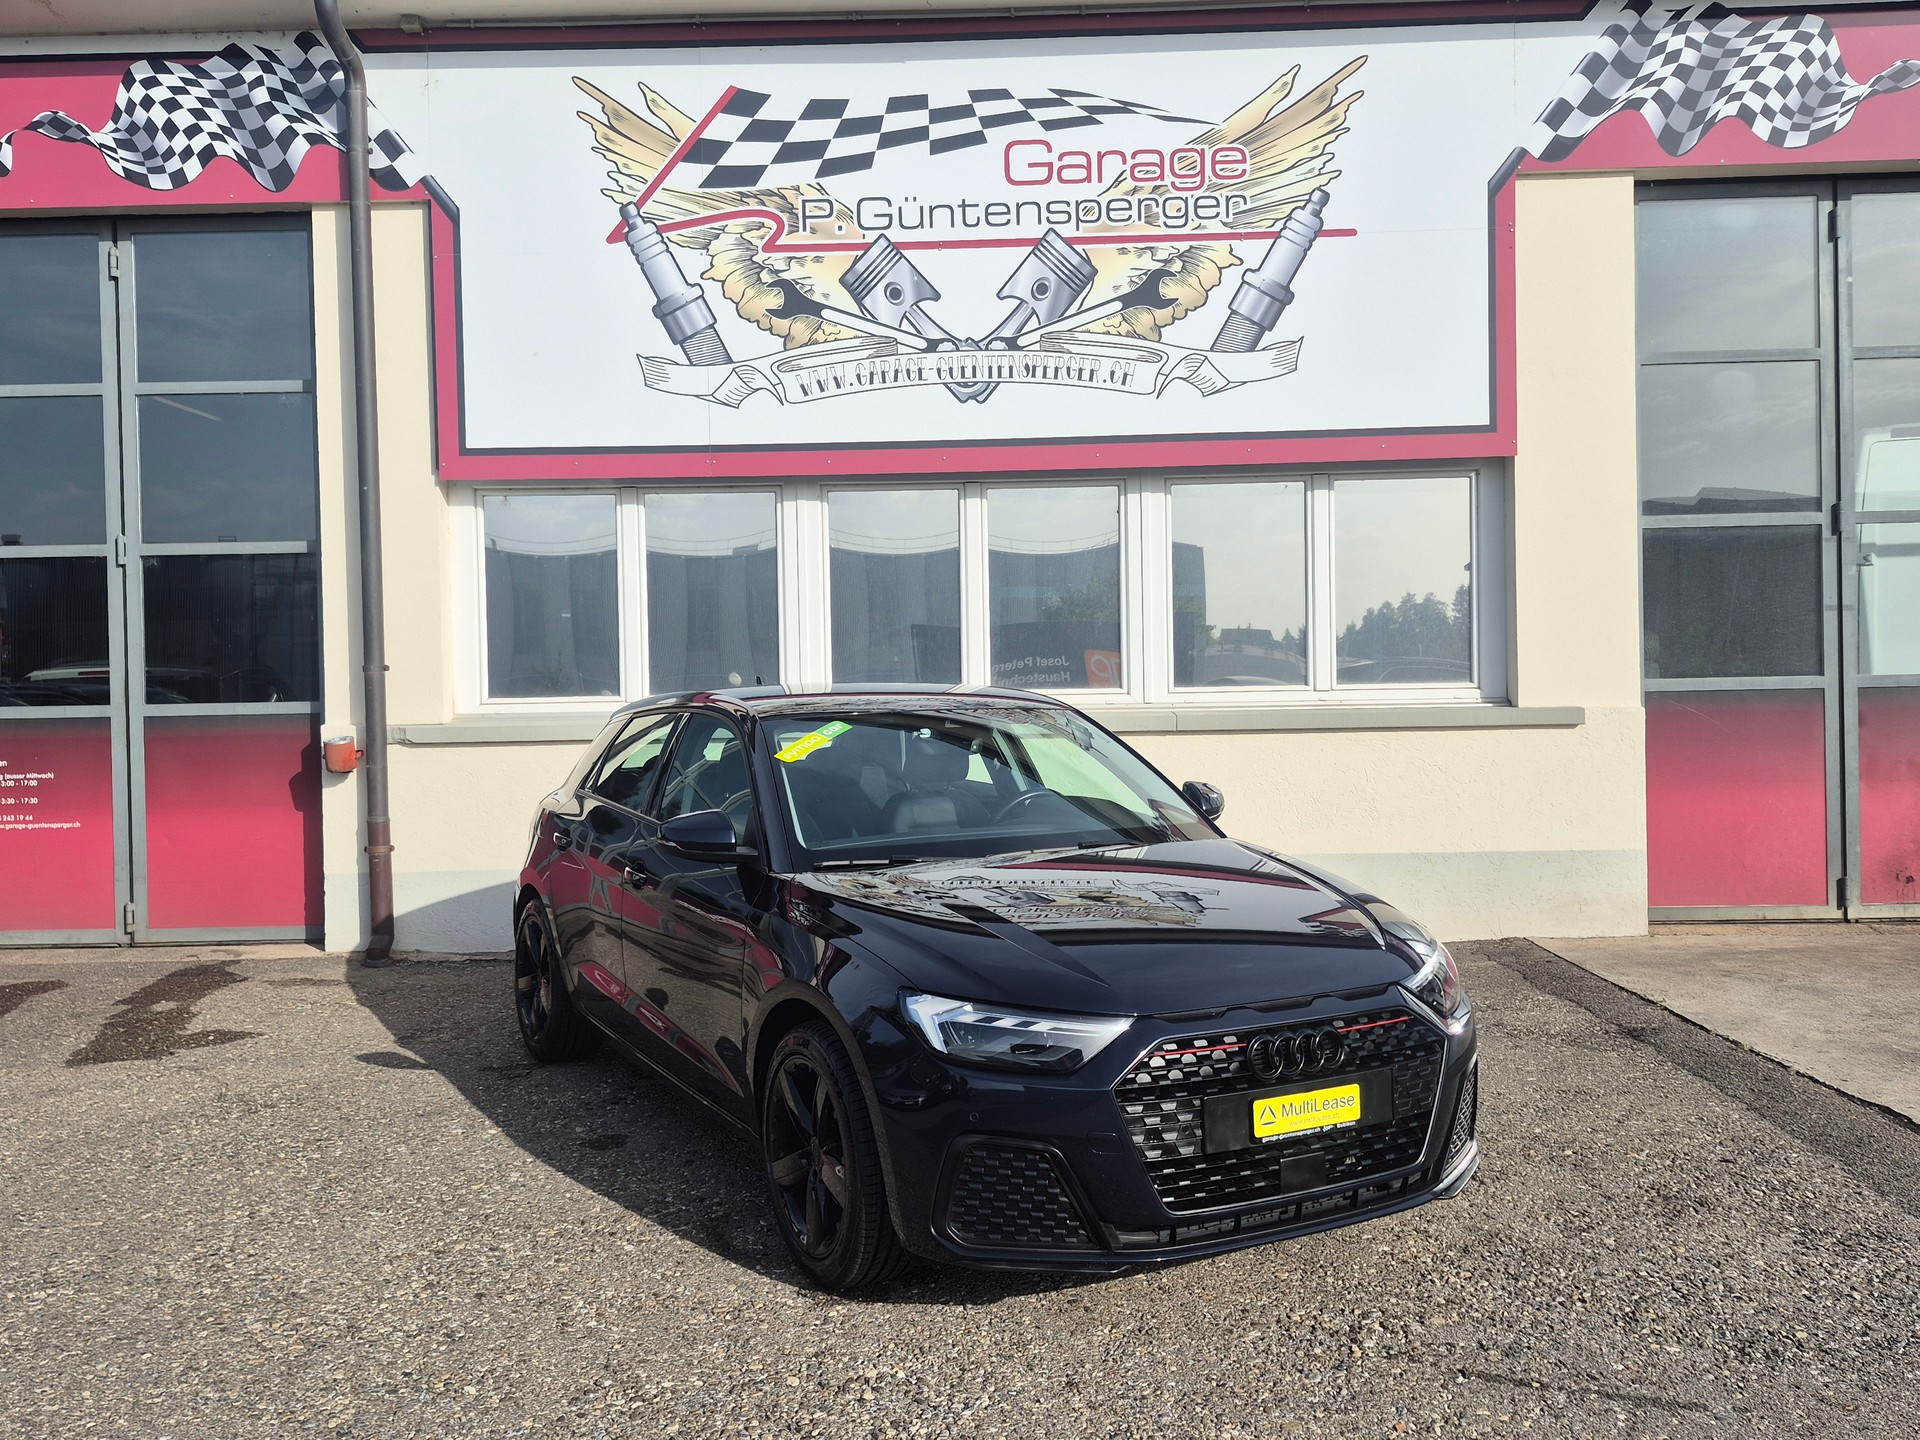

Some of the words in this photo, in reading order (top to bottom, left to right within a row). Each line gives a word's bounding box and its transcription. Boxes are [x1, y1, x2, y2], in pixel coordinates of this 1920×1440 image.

[1004, 139, 1247, 192] Garage
[856, 193, 1248, 231] Güntensperger
[794, 354, 1137, 397] WWW.GARAGE-GUENTENSPERGER.CH
[1281, 1095, 1355, 1118] MultiLease
